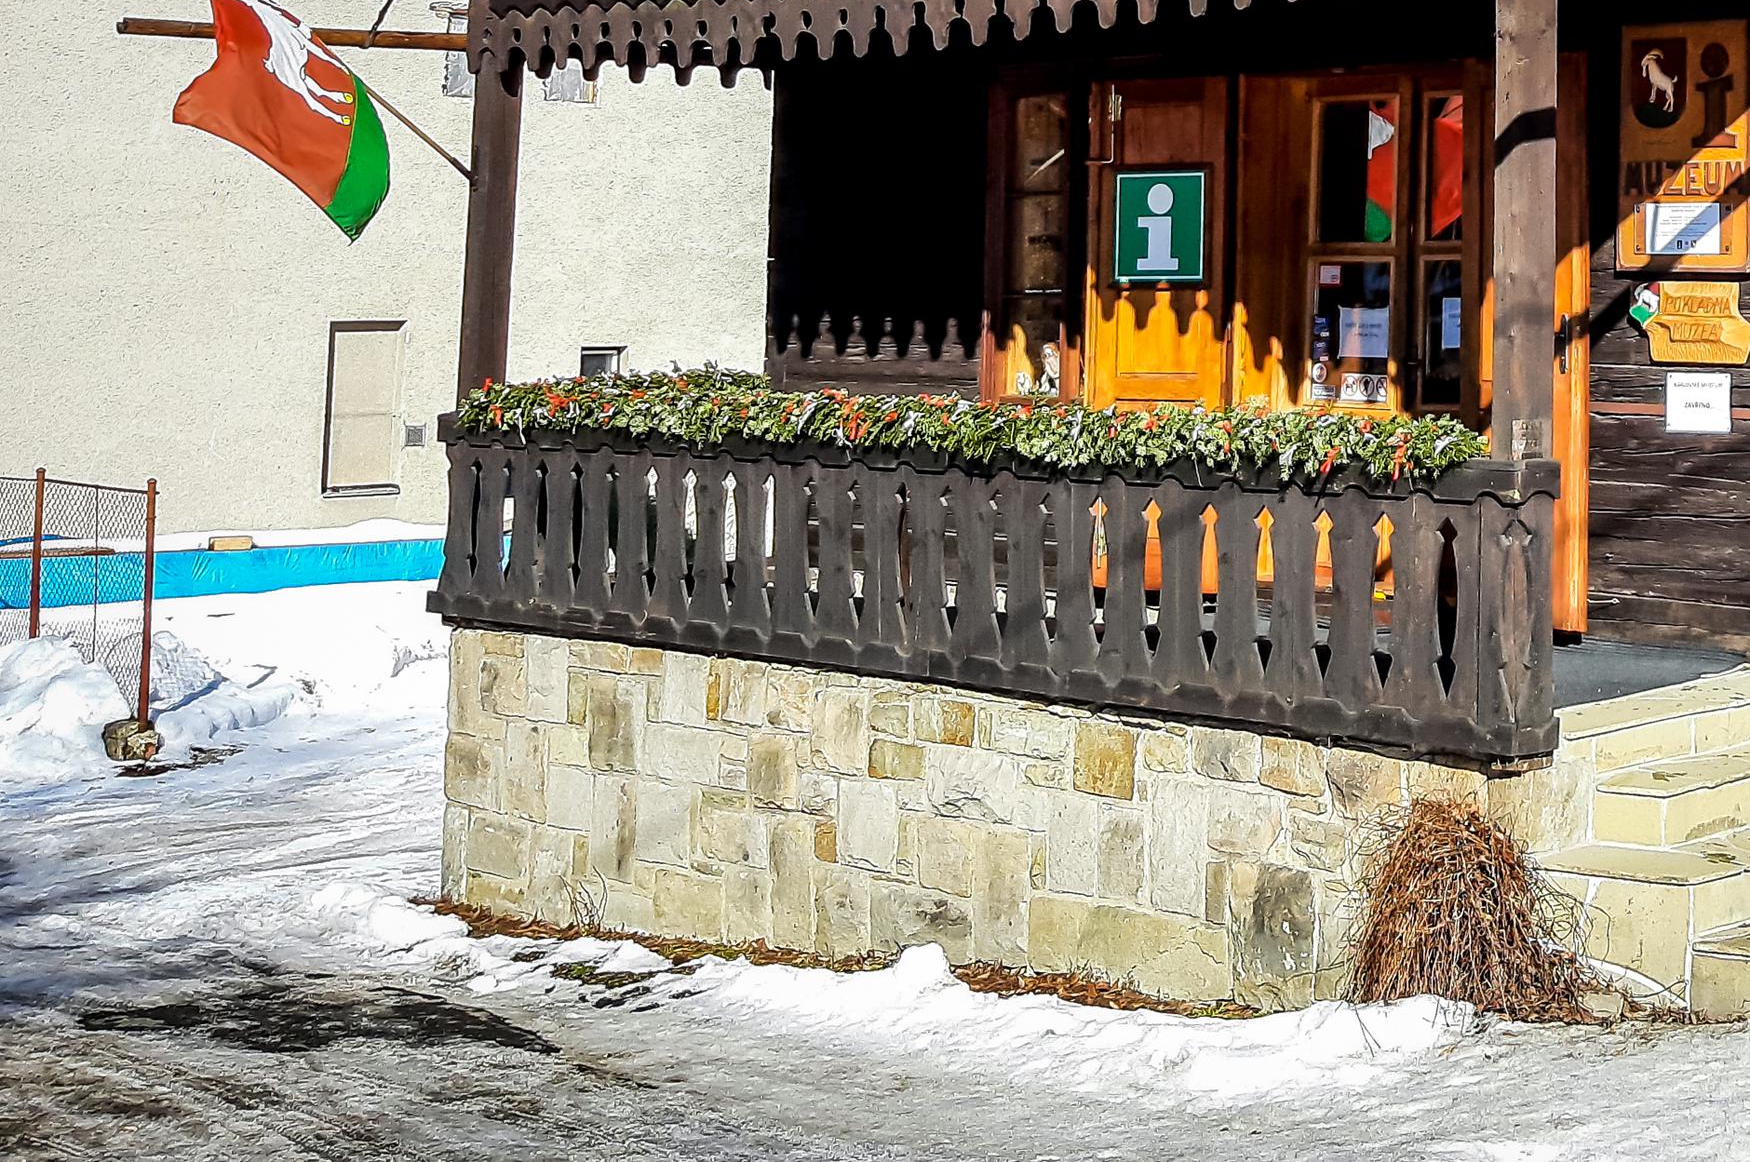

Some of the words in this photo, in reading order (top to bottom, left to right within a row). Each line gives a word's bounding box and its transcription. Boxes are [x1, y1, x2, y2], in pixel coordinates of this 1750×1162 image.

[1623, 160, 1748, 197] MUZEUM
[1663, 295, 1733, 315] POKLADNA
[1671, 321, 1721, 340] MUZEA
